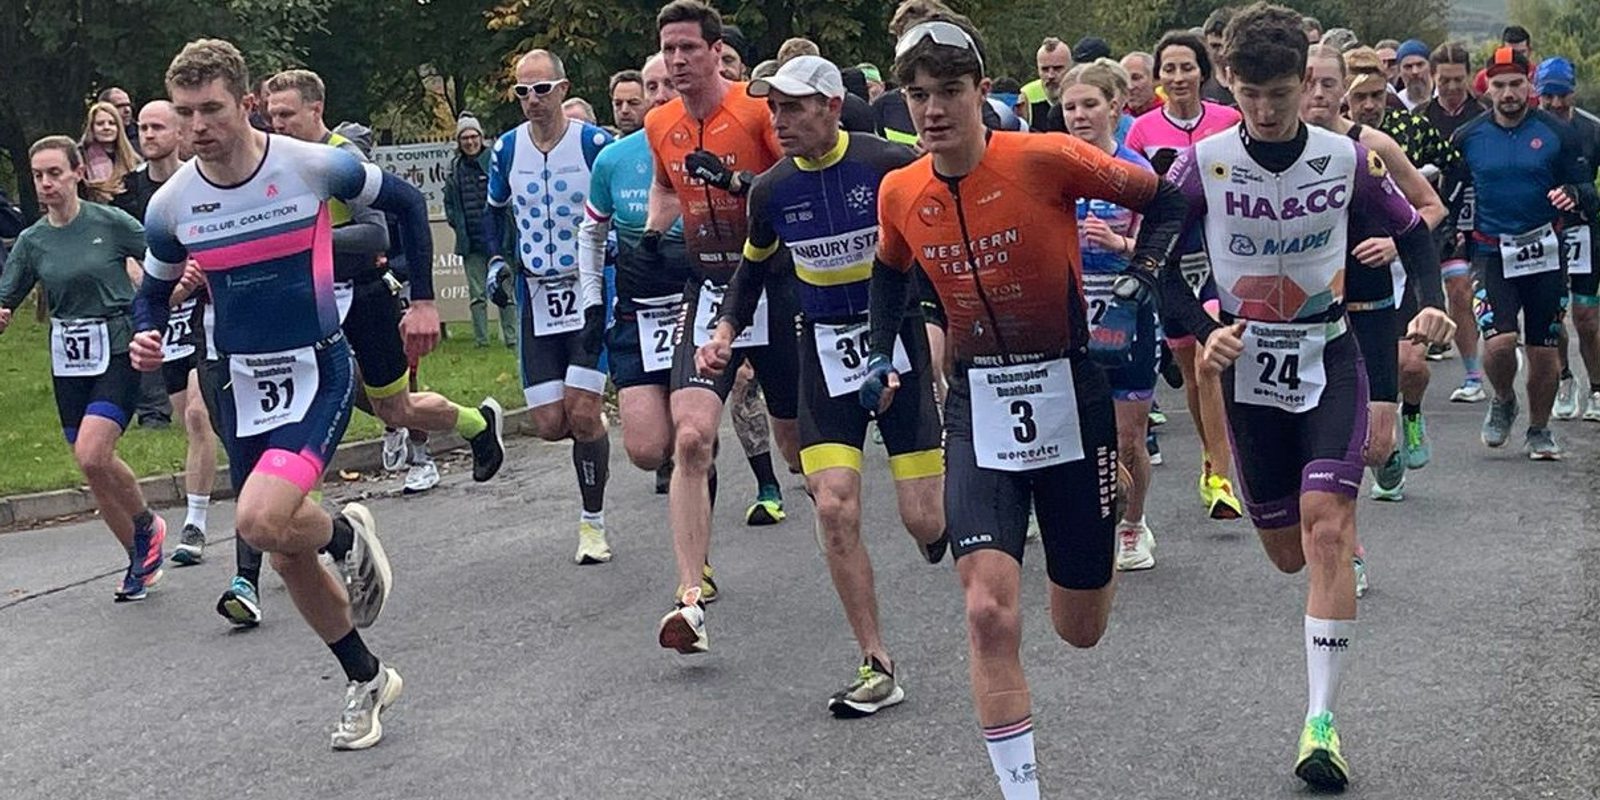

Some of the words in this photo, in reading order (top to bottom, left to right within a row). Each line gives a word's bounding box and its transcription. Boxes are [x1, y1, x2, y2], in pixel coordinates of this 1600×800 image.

[396, 149, 451, 162] COUNTRY
[620, 188, 649, 200] WYR
[1224, 184, 1347, 221] HA&CC
[793, 238, 850, 260] ANBURY
[853, 232, 880, 252] STA
[922, 229, 1019, 261] WESTERN
[1263, 227, 1335, 256] MAPEI
[940, 250, 1009, 275] TEMPO
[546, 290, 578, 319] 52
[65, 336, 91, 360] 37
[1256, 352, 1302, 391] 24
[257, 377, 295, 413] 31
[1010, 399, 1037, 444] 3
[996, 444, 1060, 461] worcester
[1096, 445, 1111, 520] WESTERN
